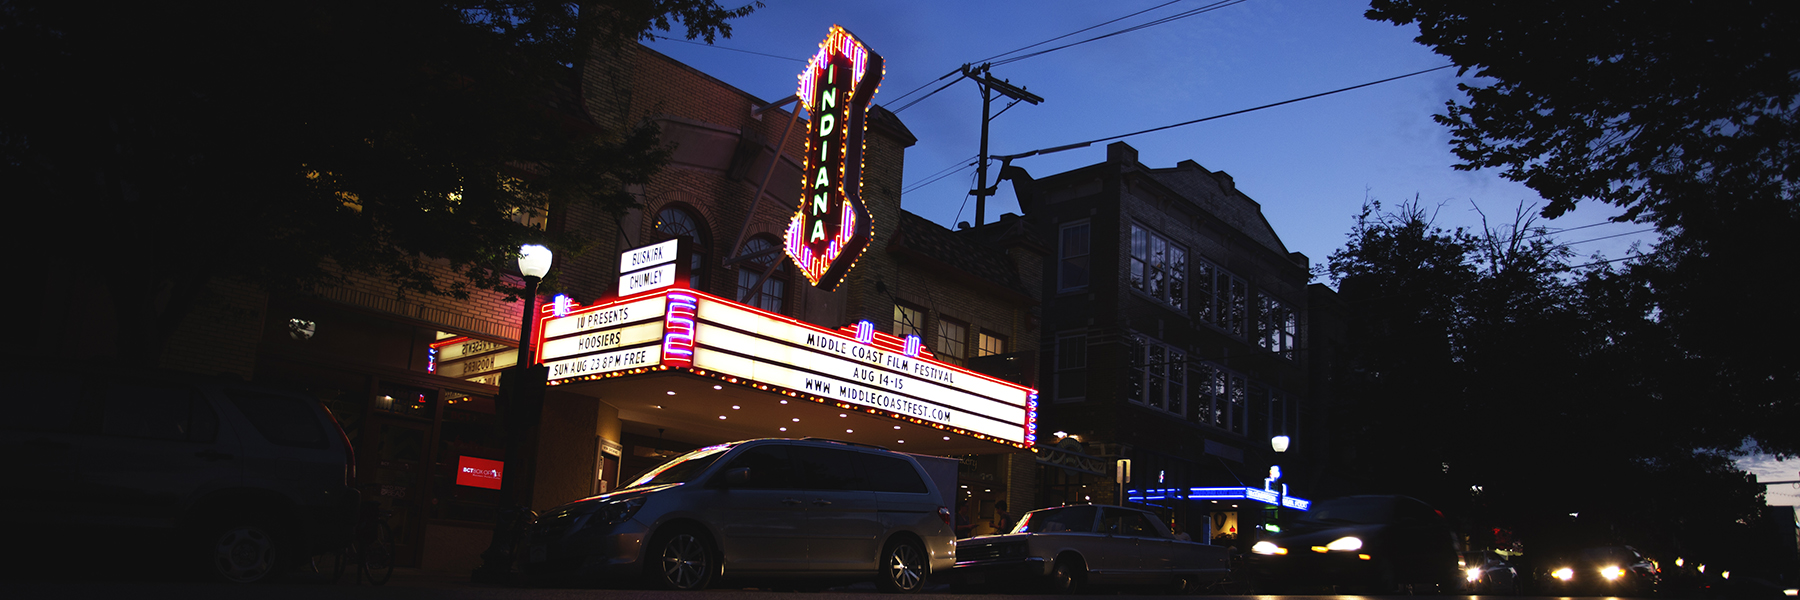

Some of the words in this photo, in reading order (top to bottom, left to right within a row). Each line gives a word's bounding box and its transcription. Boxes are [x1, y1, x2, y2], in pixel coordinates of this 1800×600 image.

[810, 63, 837, 243] INDIANA
[632, 246, 664, 266] BUSKIRK
[630, 269, 663, 289] CHUMLEY
[577, 317, 586, 329] IU
[588, 307, 629, 327] PRESENTS
[578, 331, 621, 350] HOOSIERS
[554, 364, 568, 376] SUN
[570, 360, 587, 373] AUG
[590, 358, 601, 370] 23
[602, 355, 621, 369] 8PM
[624, 350, 646, 365] FREE
[806, 333, 847, 354] MIDDLE
[851, 345, 884, 364] COAST
[886, 355, 908, 371] FILM
[914, 363, 954, 383] FESTIVAL
[853, 367, 875, 382] AUG
[879, 373, 904, 389] 14-15
[805, 377, 831, 394] WWW
[840, 386, 951, 422] MIDDLECOASTFEST.COM
